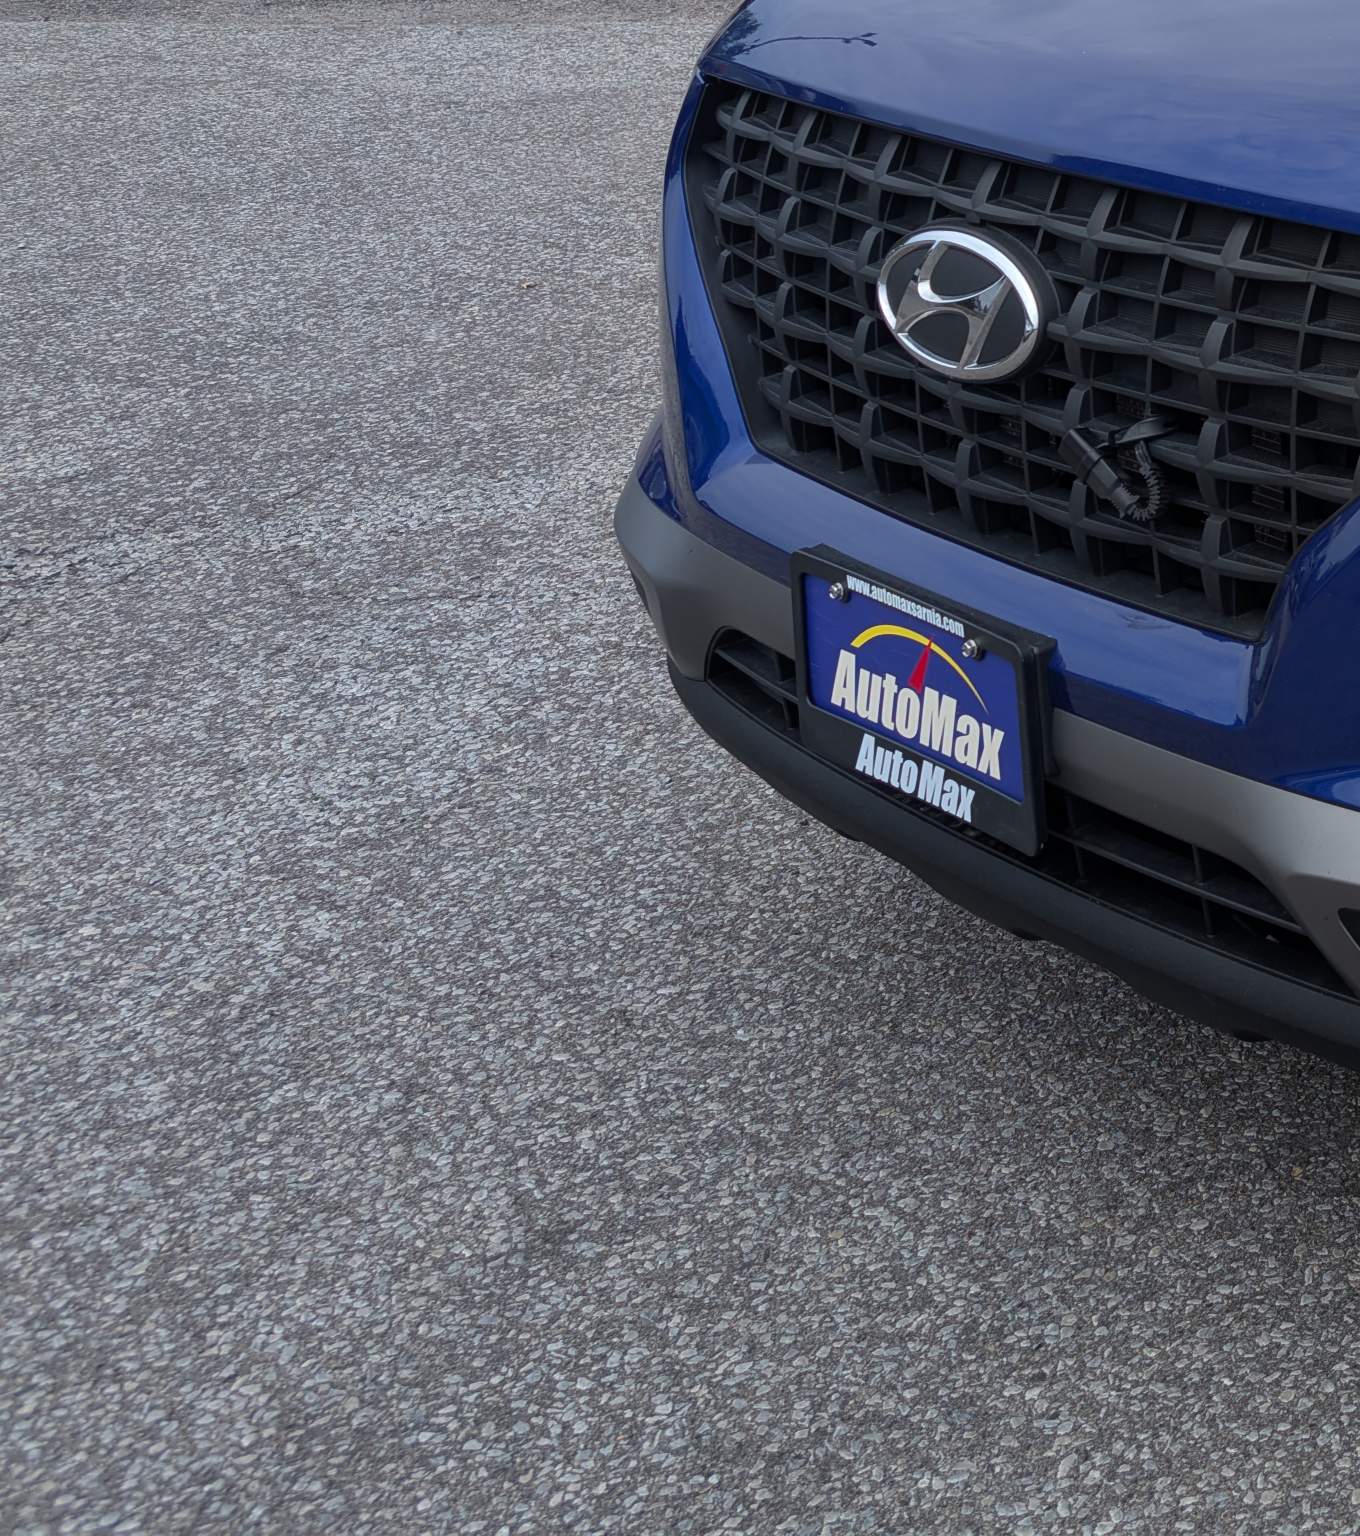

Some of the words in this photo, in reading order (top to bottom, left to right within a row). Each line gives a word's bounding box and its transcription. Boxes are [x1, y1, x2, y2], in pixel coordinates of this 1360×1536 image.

[846, 573, 965, 639] www.automaxsarnia.com
[830, 648, 1005, 781] AutoMax
[855, 733, 976, 824] AutoMax
